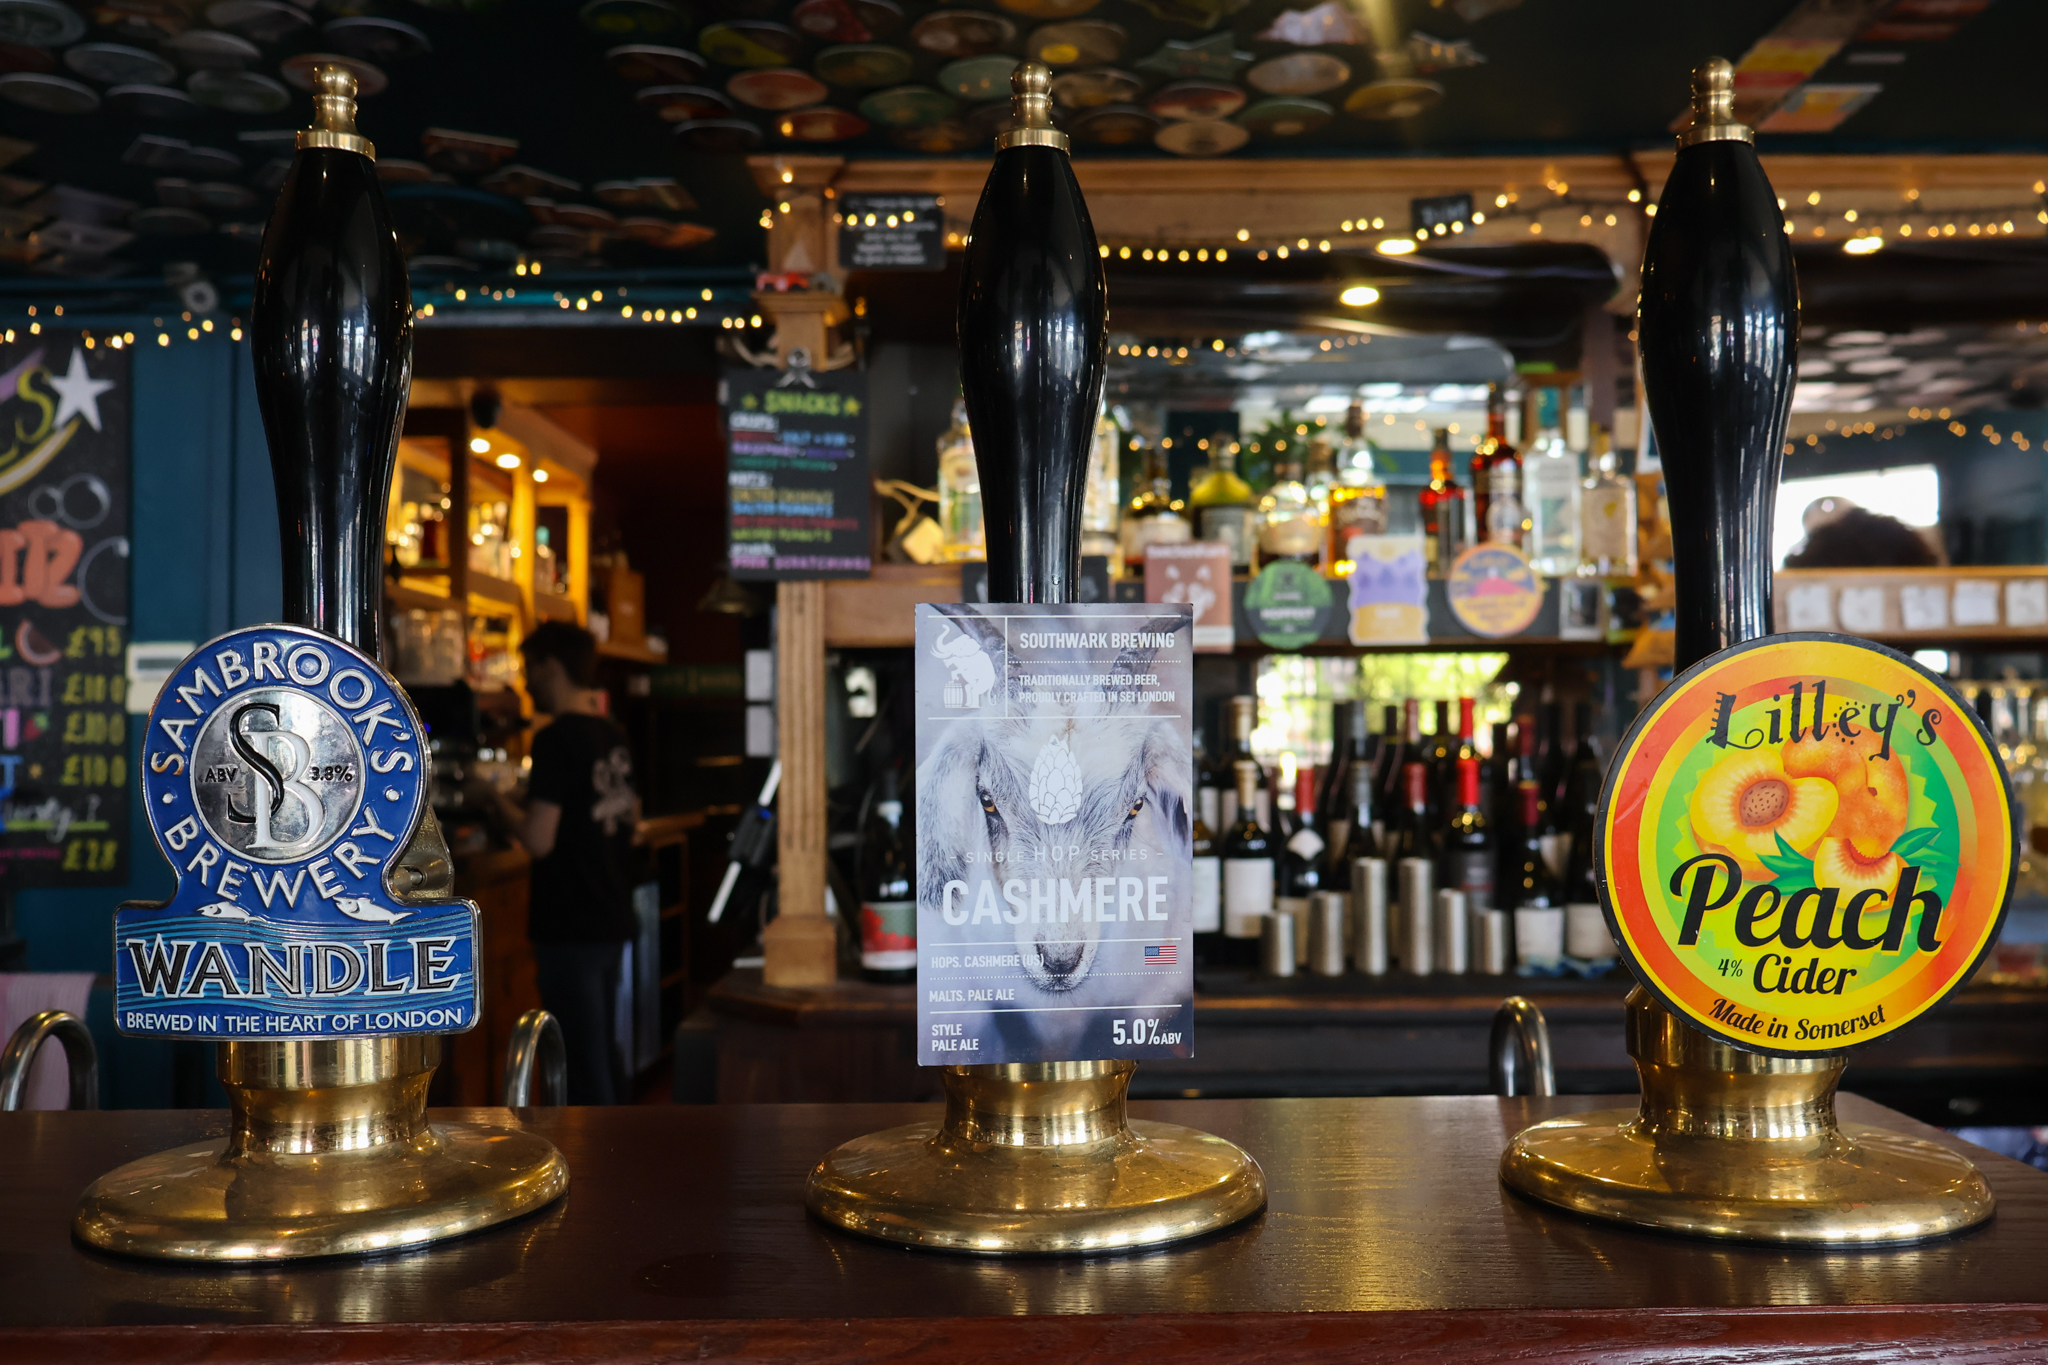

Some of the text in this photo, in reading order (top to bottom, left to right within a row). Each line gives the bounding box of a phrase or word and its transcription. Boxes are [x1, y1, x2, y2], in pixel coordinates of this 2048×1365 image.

[1020, 633, 1108, 649] SOUTHWARK
[1019, 674, 1160, 686] TRADITIONALLY BREWED BEER,
[1019, 691, 1175, 702] PROUDLY CRAFTED IN SE1 LONDON
[151, 641, 413, 776] SAMBROOK'S
[1705, 680, 1942, 761] Lilley's
[205, 766, 353, 783] ABV 3.8%
[165, 808, 396, 909] BREWERY
[966, 846, 1148, 863] SINGLE HOP SERIES
[942, 876, 1169, 926] CASHMERE
[1669, 853, 1944, 953] Peach
[126, 933, 462, 998] WANDLE
[964, 954, 1020, 968] CASHMERE
[1022, 954, 1045, 968] (US)
[1717, 953, 1858, 996] 4% Cider
[929, 989, 1014, 1002] MALTS. PALE ALE
[127, 1008, 462, 1032] BREWED IN THE HEART OF LONDON
[1709, 998, 1886, 1040] Made in Somerset
[931, 1024, 962, 1036] STYLE
[932, 1039, 979, 1051] PALE ALE
